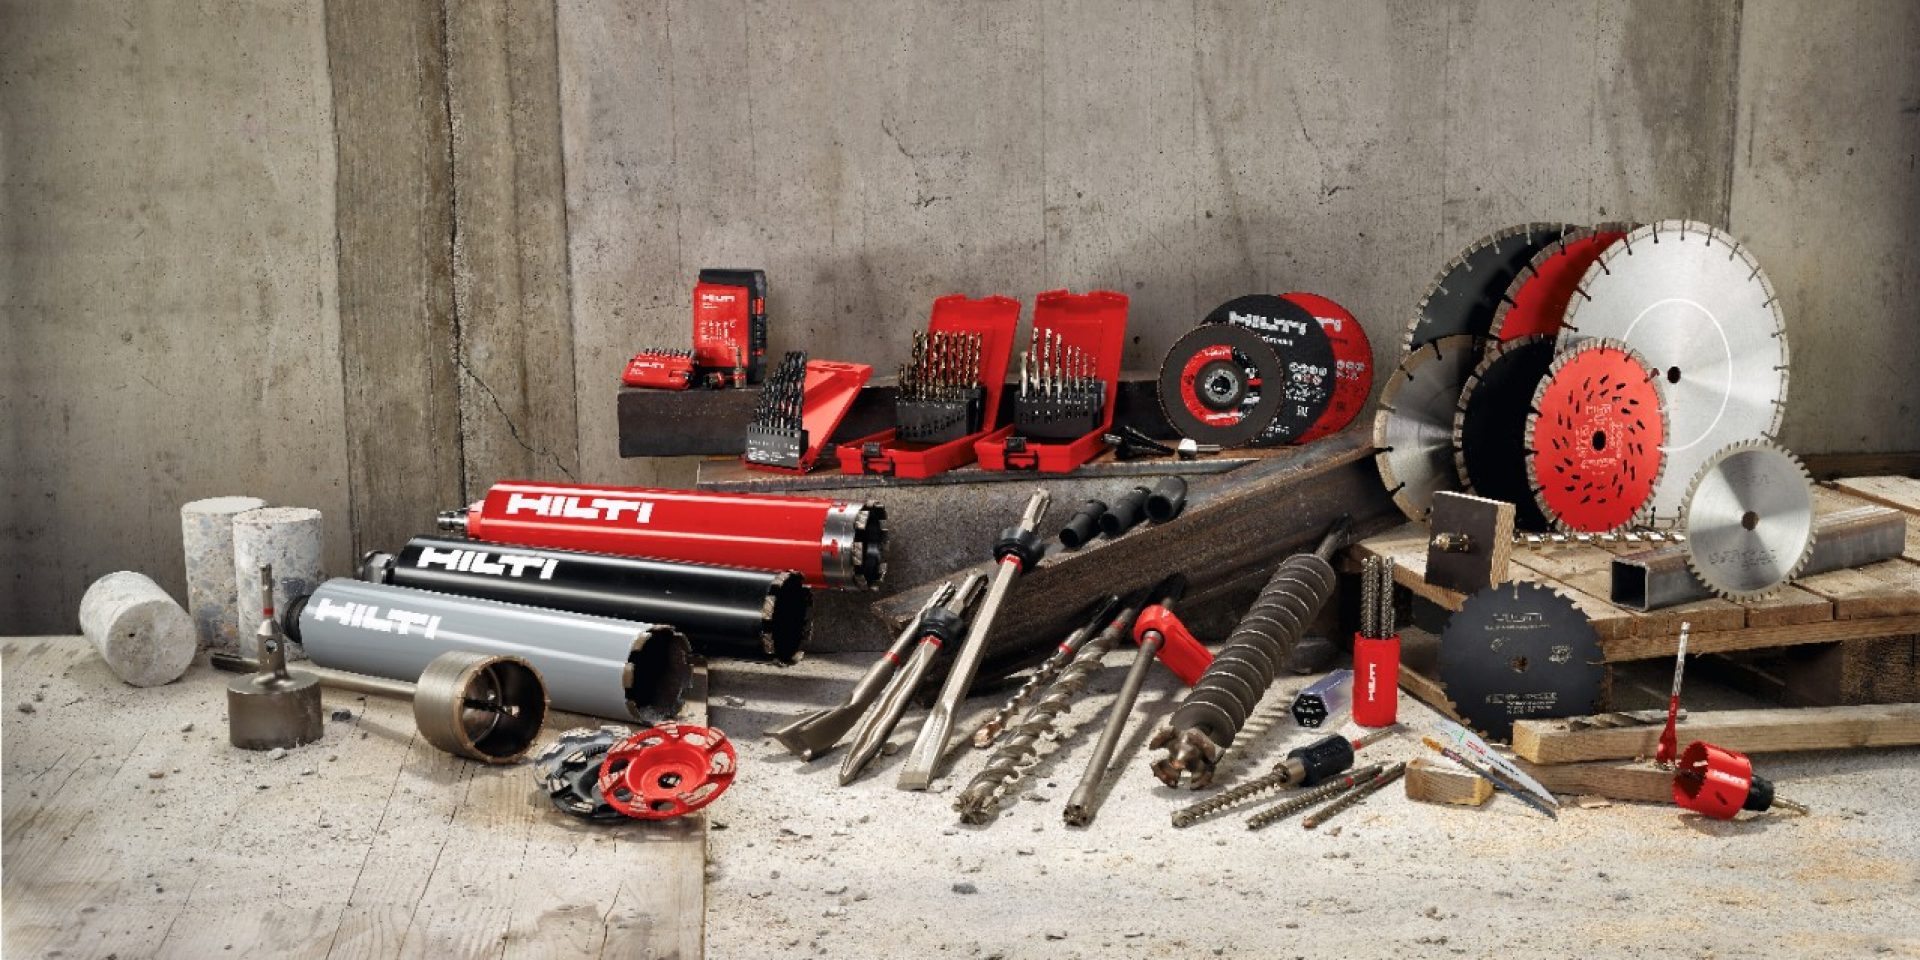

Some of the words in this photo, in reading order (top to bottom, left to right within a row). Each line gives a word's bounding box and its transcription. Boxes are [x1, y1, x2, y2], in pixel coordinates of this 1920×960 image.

[1229, 310, 1308, 336] HILTI
[505, 493, 654, 524] HILTI
[417, 547, 559, 580] HILTI
[314, 598, 442, 640] HILTI
[1368, 663, 1377, 701] HILTI
